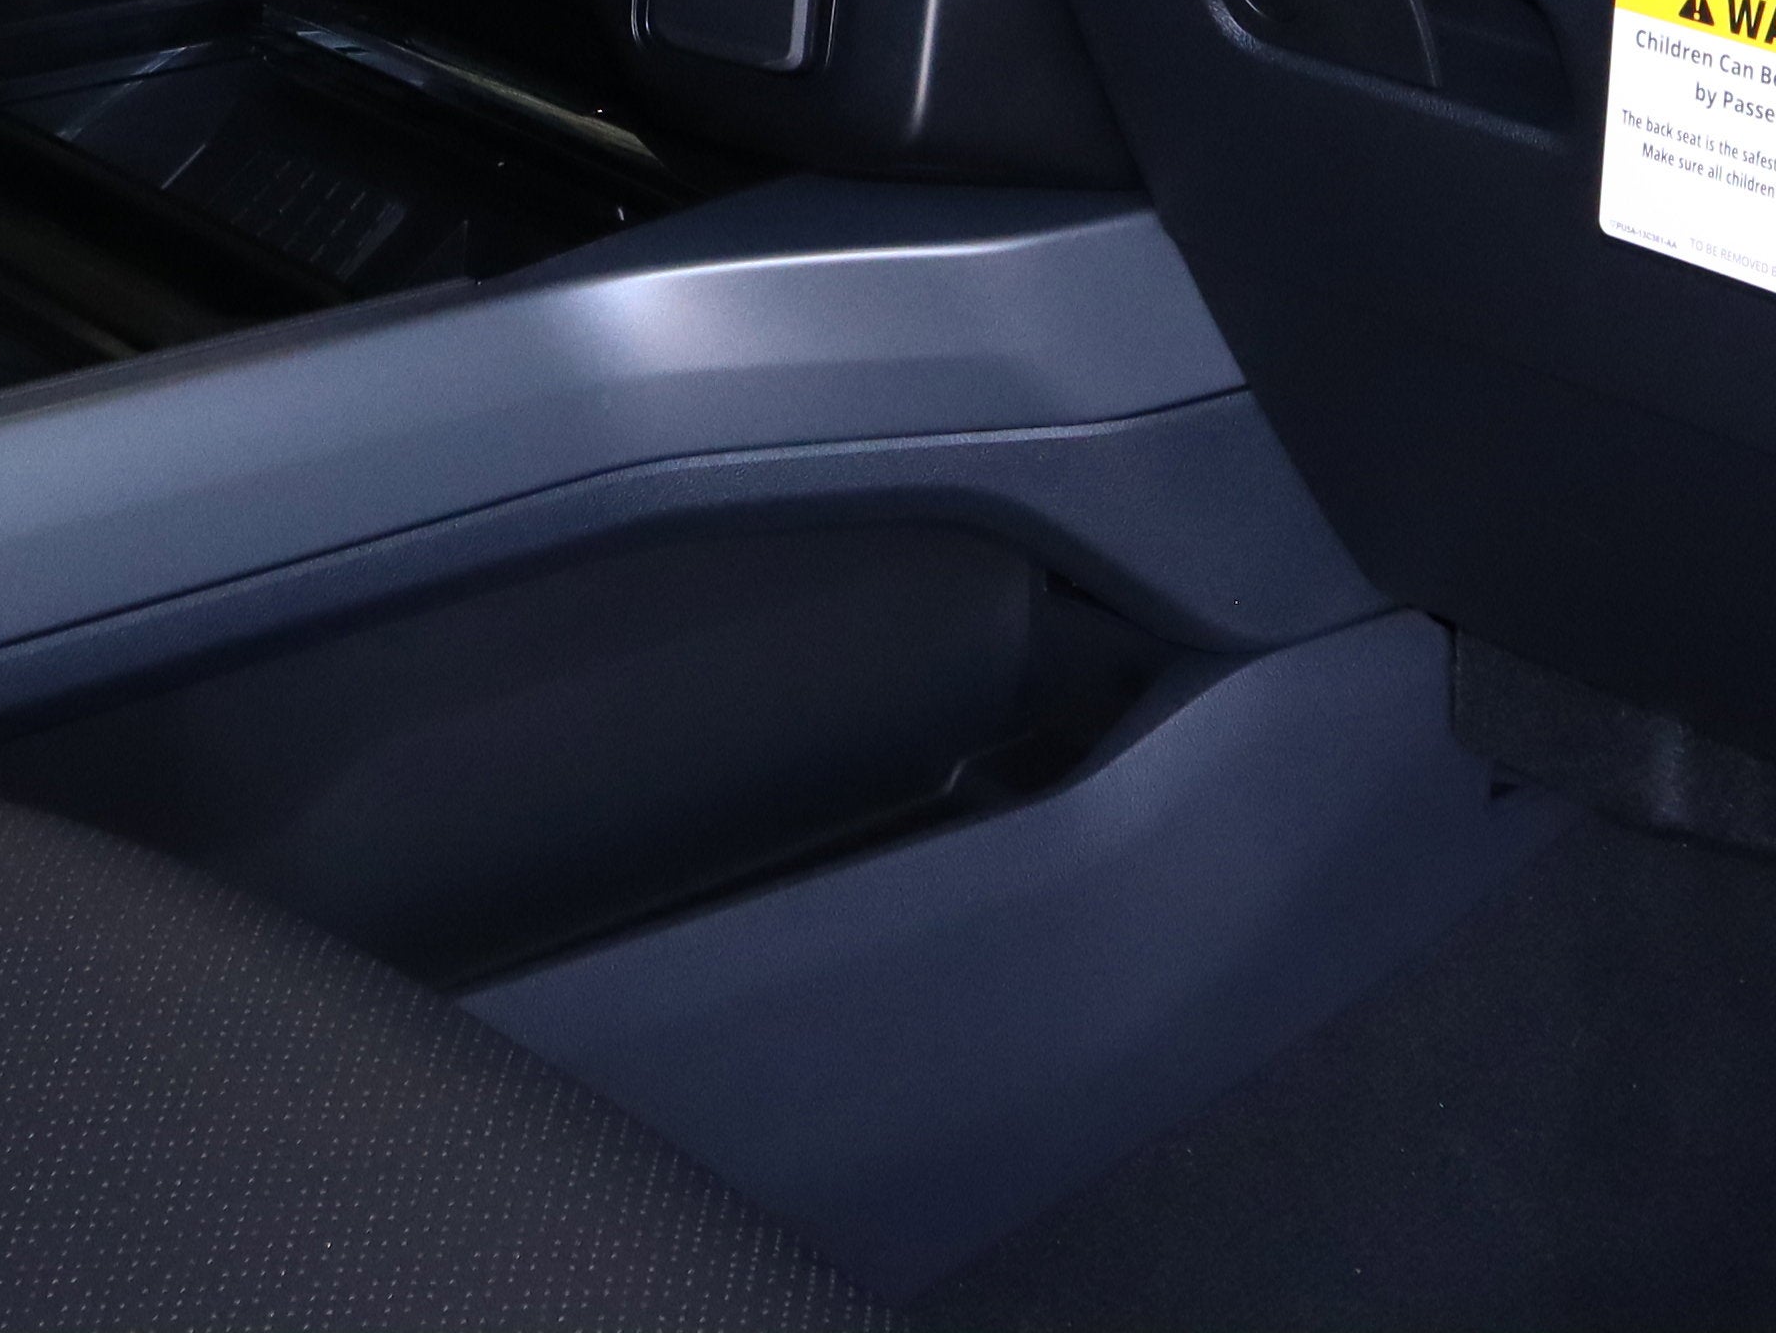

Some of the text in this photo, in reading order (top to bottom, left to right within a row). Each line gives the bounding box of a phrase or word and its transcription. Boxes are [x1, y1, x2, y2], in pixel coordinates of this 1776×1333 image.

[1635, 28, 1713, 68] Children
[1718, 53, 1754, 81] Can
[1694, 80, 1718, 110] by
[1621, 108, 1643, 130] The
[1645, 115, 1674, 140] back
[1675, 129, 1702, 149] seat
[1704, 134, 1715, 153] is
[1718, 139, 1739, 160] the
[1641, 141, 1675, 167] Make
[1677, 156, 1704, 176] sure
[1706, 164, 1723, 182] all
[1725, 169, 1775, 199] children
[1689, 238, 1704, 254] TO
[1705, 242, 1721, 259] BE
[1721, 247, 1769, 275] REMOVED
